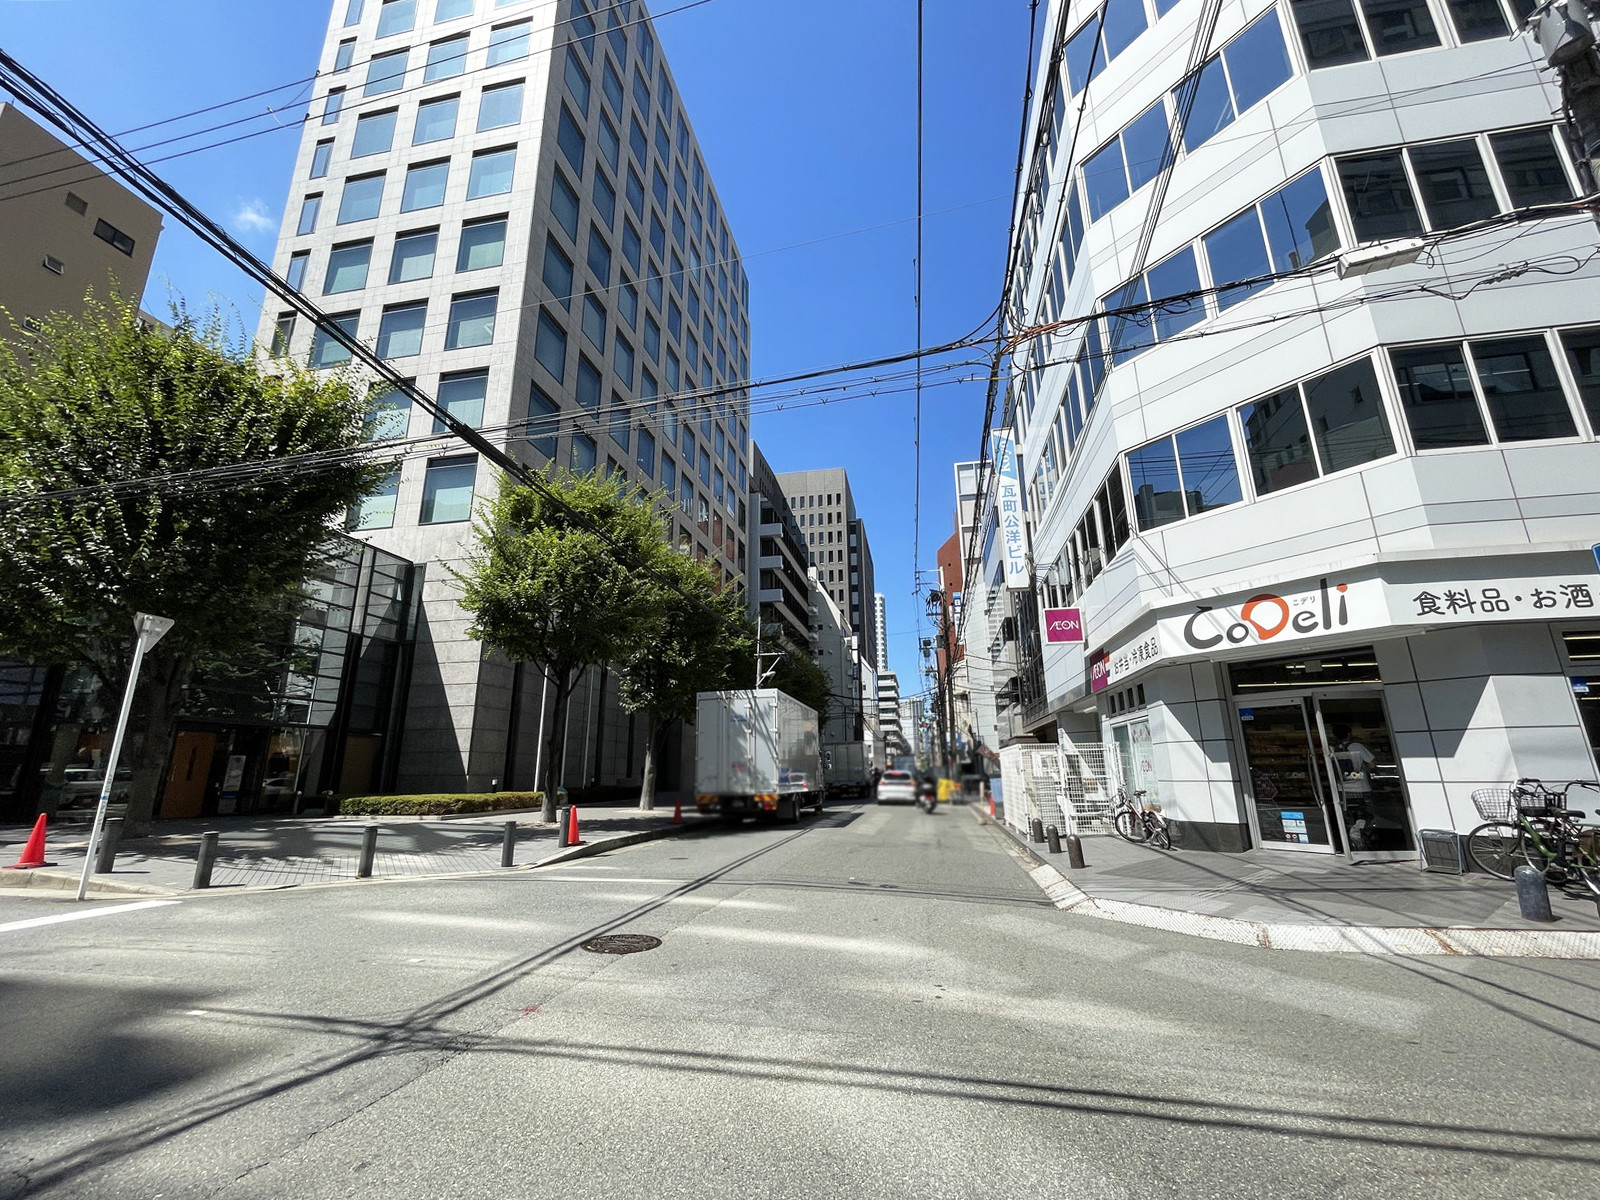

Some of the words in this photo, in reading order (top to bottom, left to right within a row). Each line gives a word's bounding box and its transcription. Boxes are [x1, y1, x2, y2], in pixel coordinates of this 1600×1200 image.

[1001, 485, 1024, 575] 瓦町公洋ビル
[1184, 578, 1348, 649] CoDeli
[1413, 584, 1594, 616] 食料品・お酒
